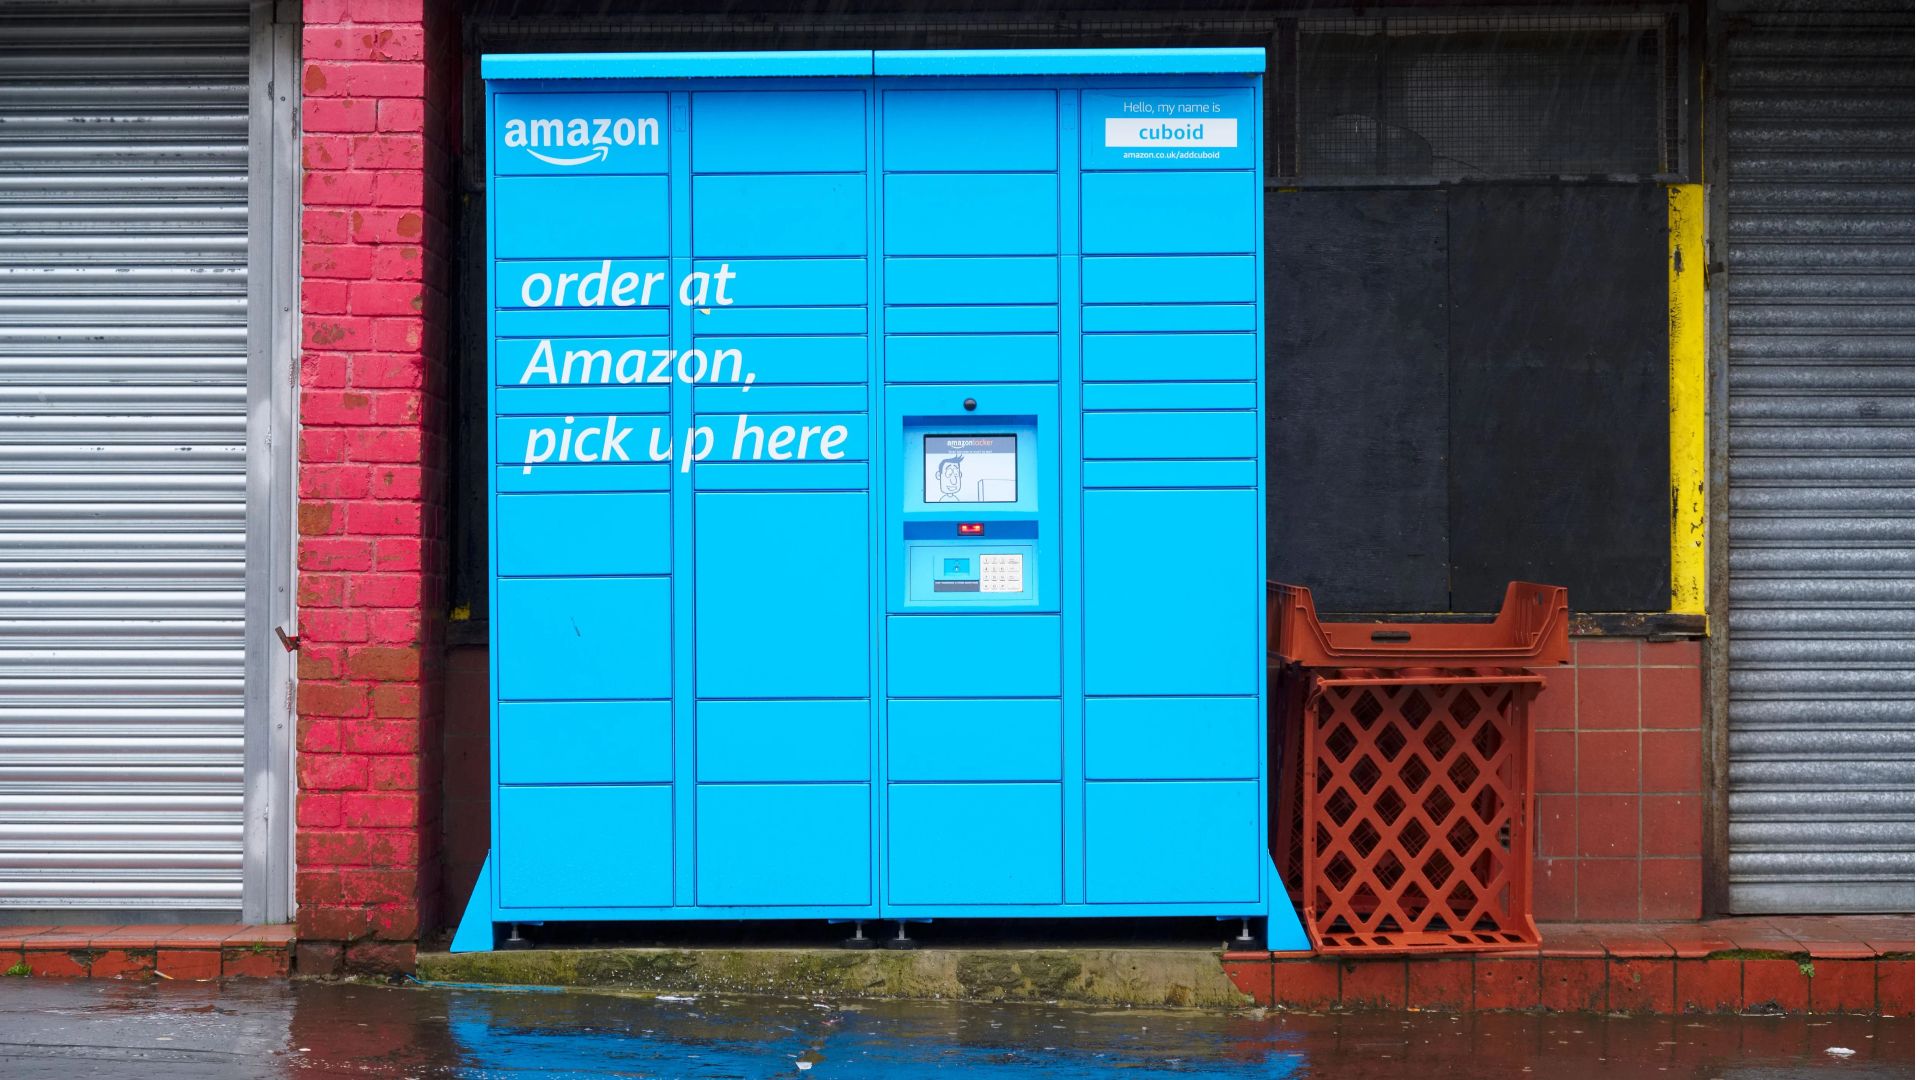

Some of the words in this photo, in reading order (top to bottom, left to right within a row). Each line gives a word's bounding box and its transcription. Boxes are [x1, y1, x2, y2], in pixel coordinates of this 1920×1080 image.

[1125, 102, 1154, 114] Hello,
[1158, 104, 1175, 115] my
[1178, 104, 1209, 113] name
[1212, 102, 1220, 113] is
[505, 117, 660, 148] amazon
[1140, 124, 1204, 140] cuboid
[1124, 151, 1220, 160] amazon.co.uk/addcuboid
[521, 259, 665, 308] order
[679, 263, 737, 308] at
[520, 338, 757, 393] Amazon,
[522, 415, 634, 475] pick
[647, 415, 715, 474] up
[731, 413, 849, 461] here
